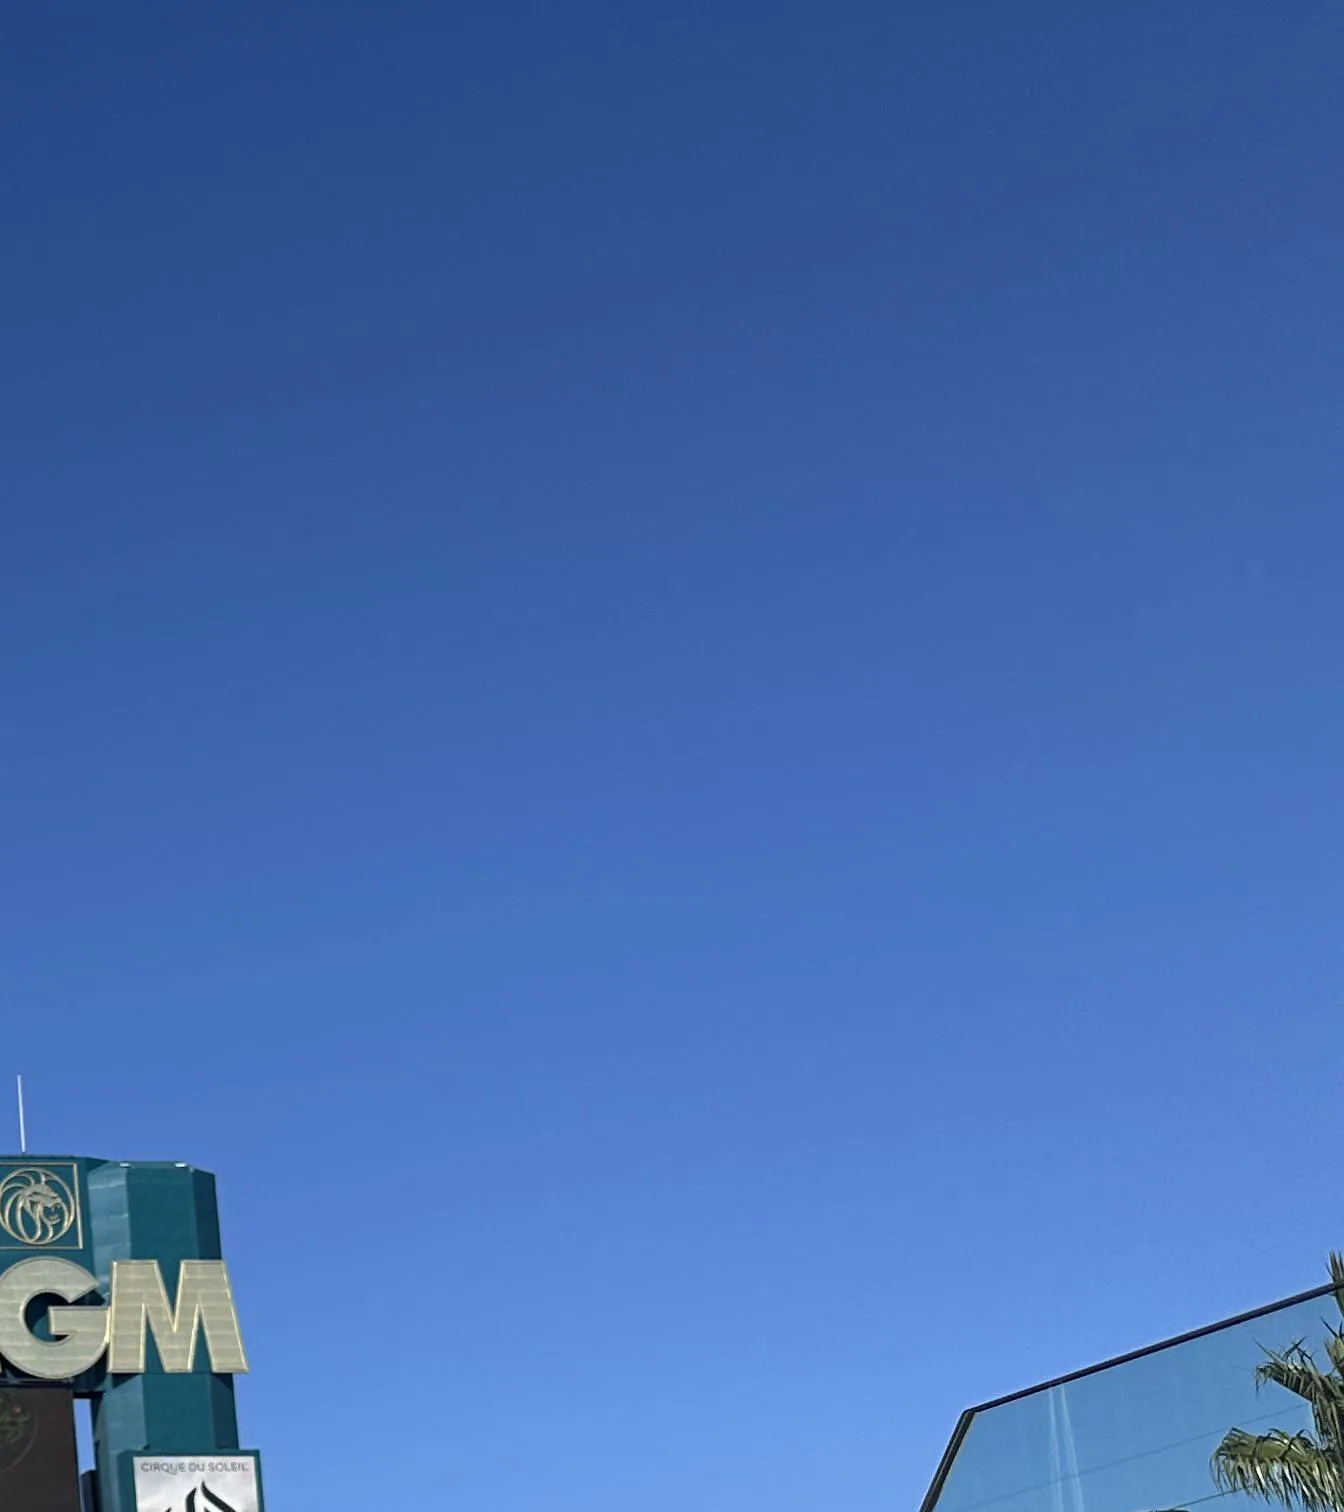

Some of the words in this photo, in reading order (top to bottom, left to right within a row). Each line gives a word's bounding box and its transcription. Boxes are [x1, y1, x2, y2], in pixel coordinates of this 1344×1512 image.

[140, 1462, 185, 1475] CIRQUE
[188, 1462, 205, 1473] DU
[207, 1462, 249, 1473] SOLEIL
